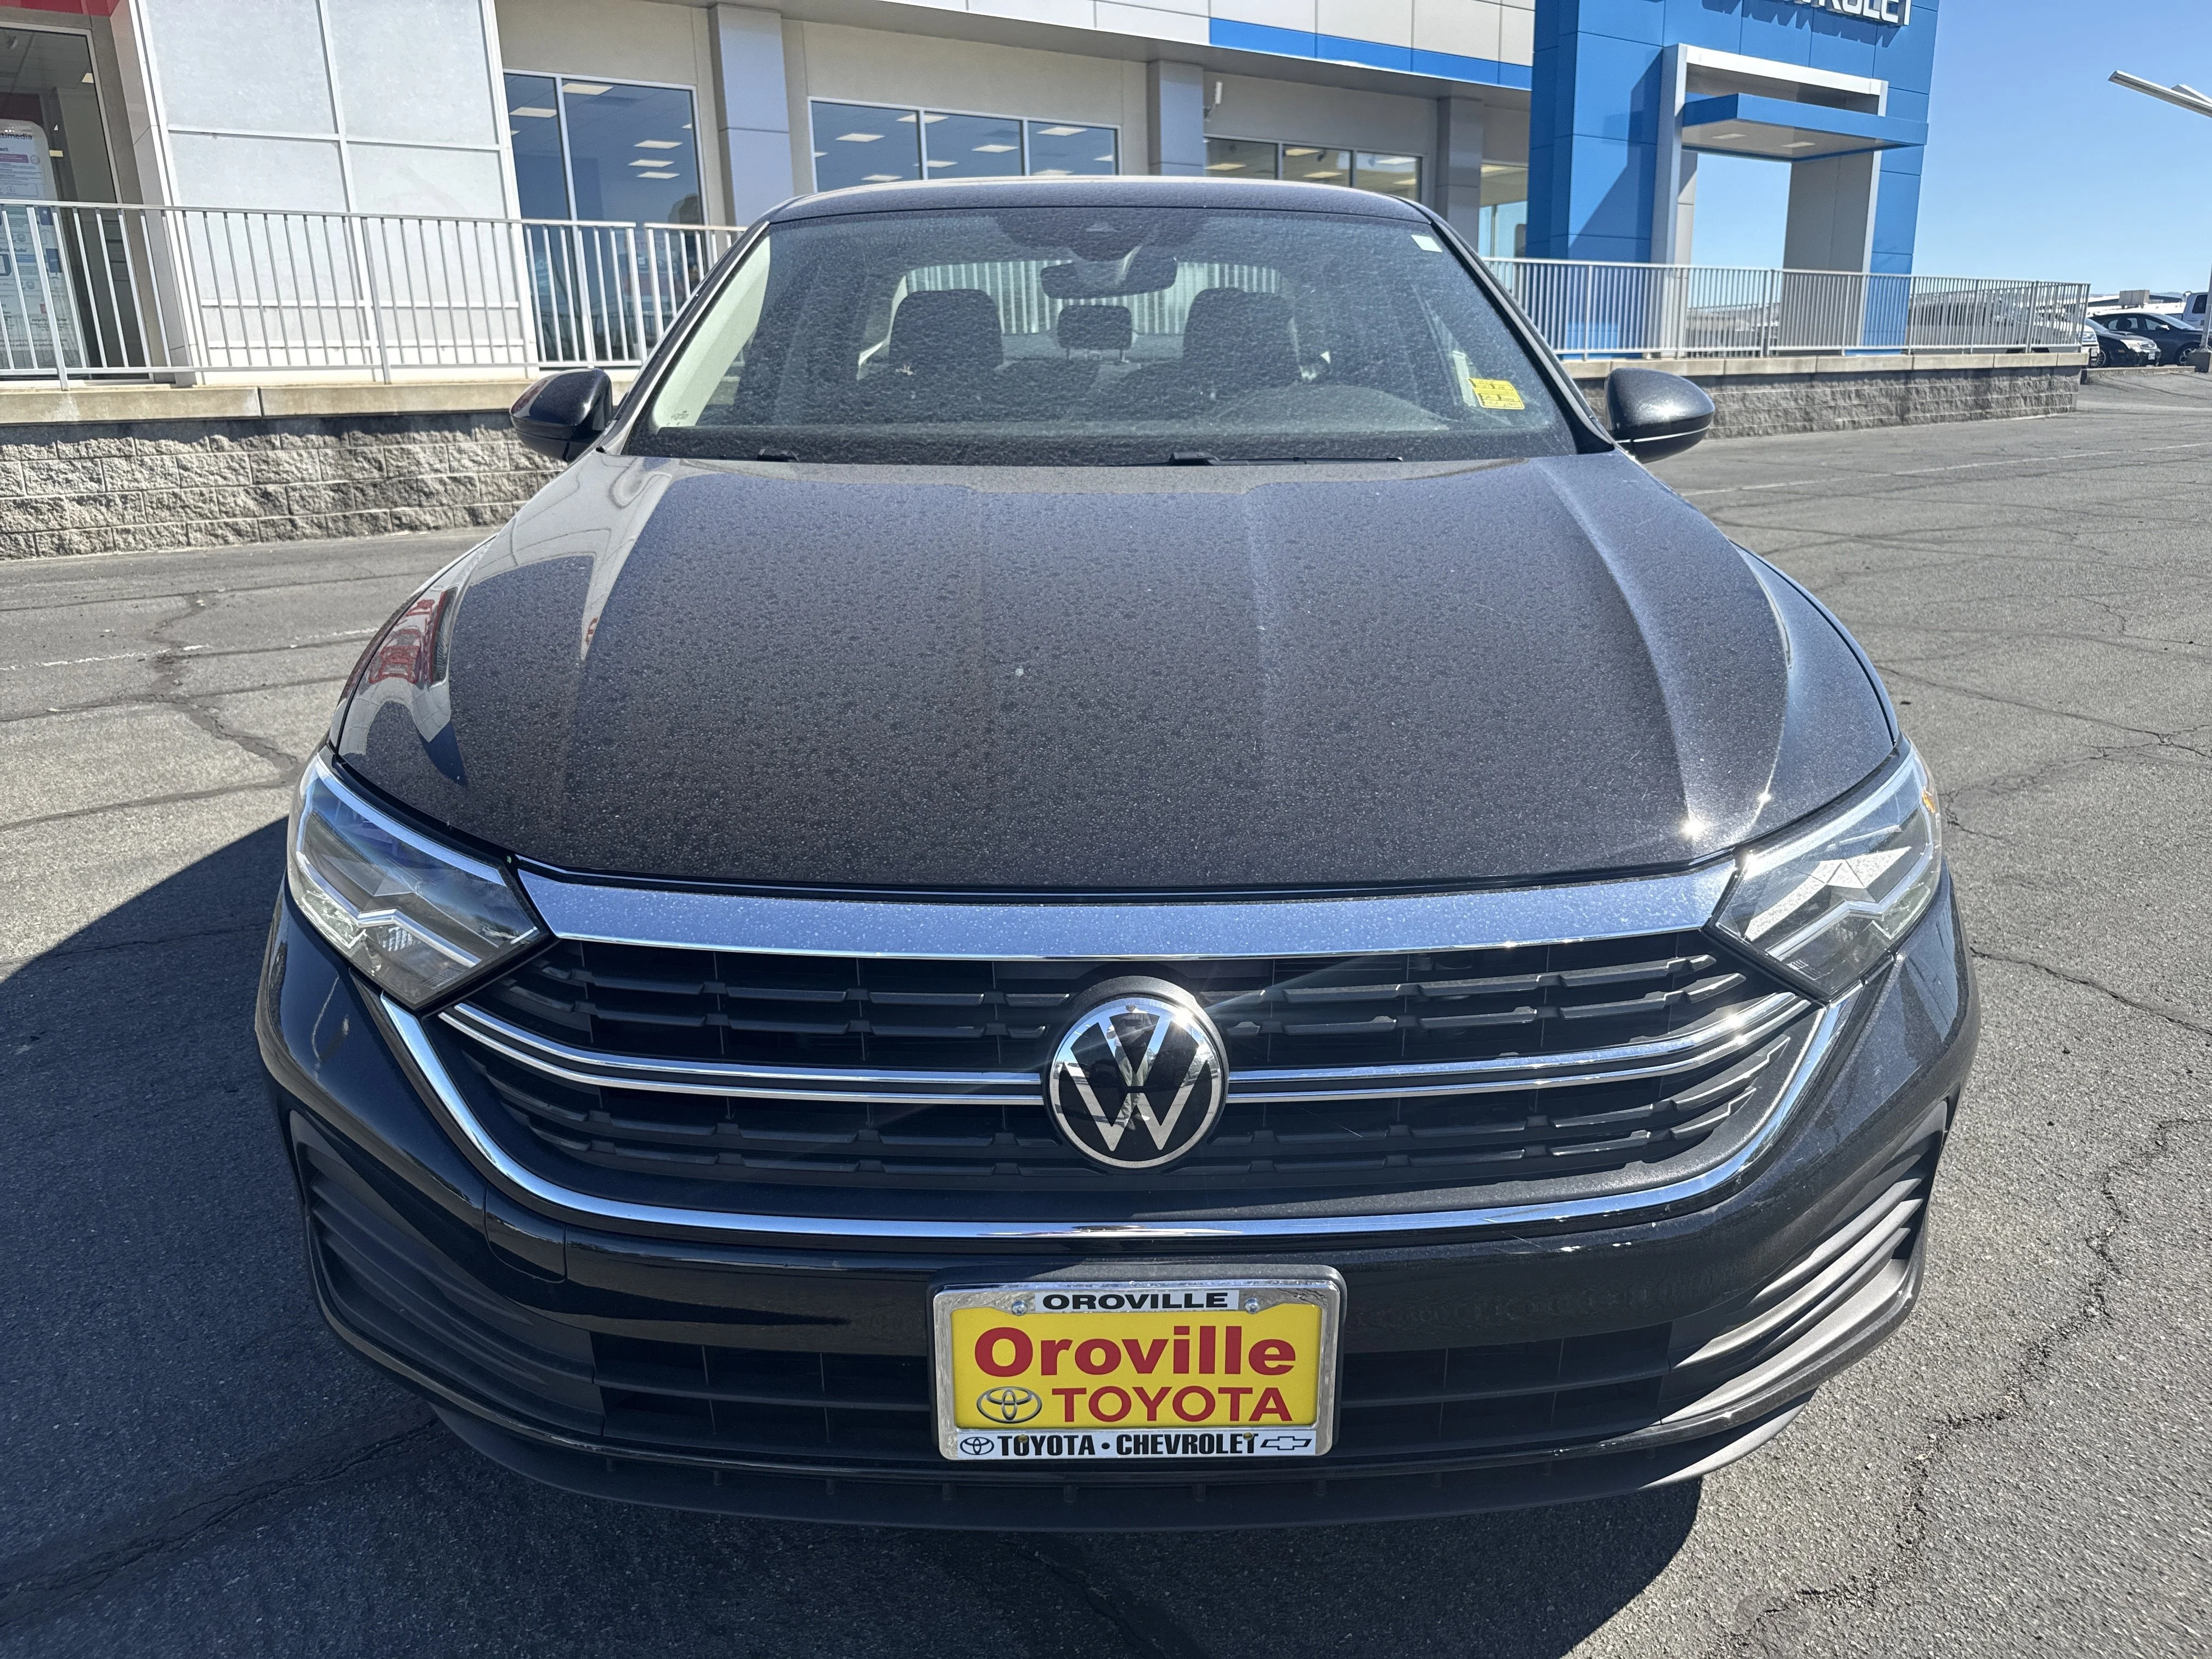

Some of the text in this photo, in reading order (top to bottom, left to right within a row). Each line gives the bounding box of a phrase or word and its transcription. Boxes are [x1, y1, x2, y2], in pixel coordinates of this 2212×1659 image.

[1042, 1291, 1228, 1311] OROVILLE
[974, 1325, 1296, 1378] Oroville
[1052, 1386, 1293, 1423] TOYOTA
[996, 1432, 1260, 1457] TOYOTA CHEVROLET
